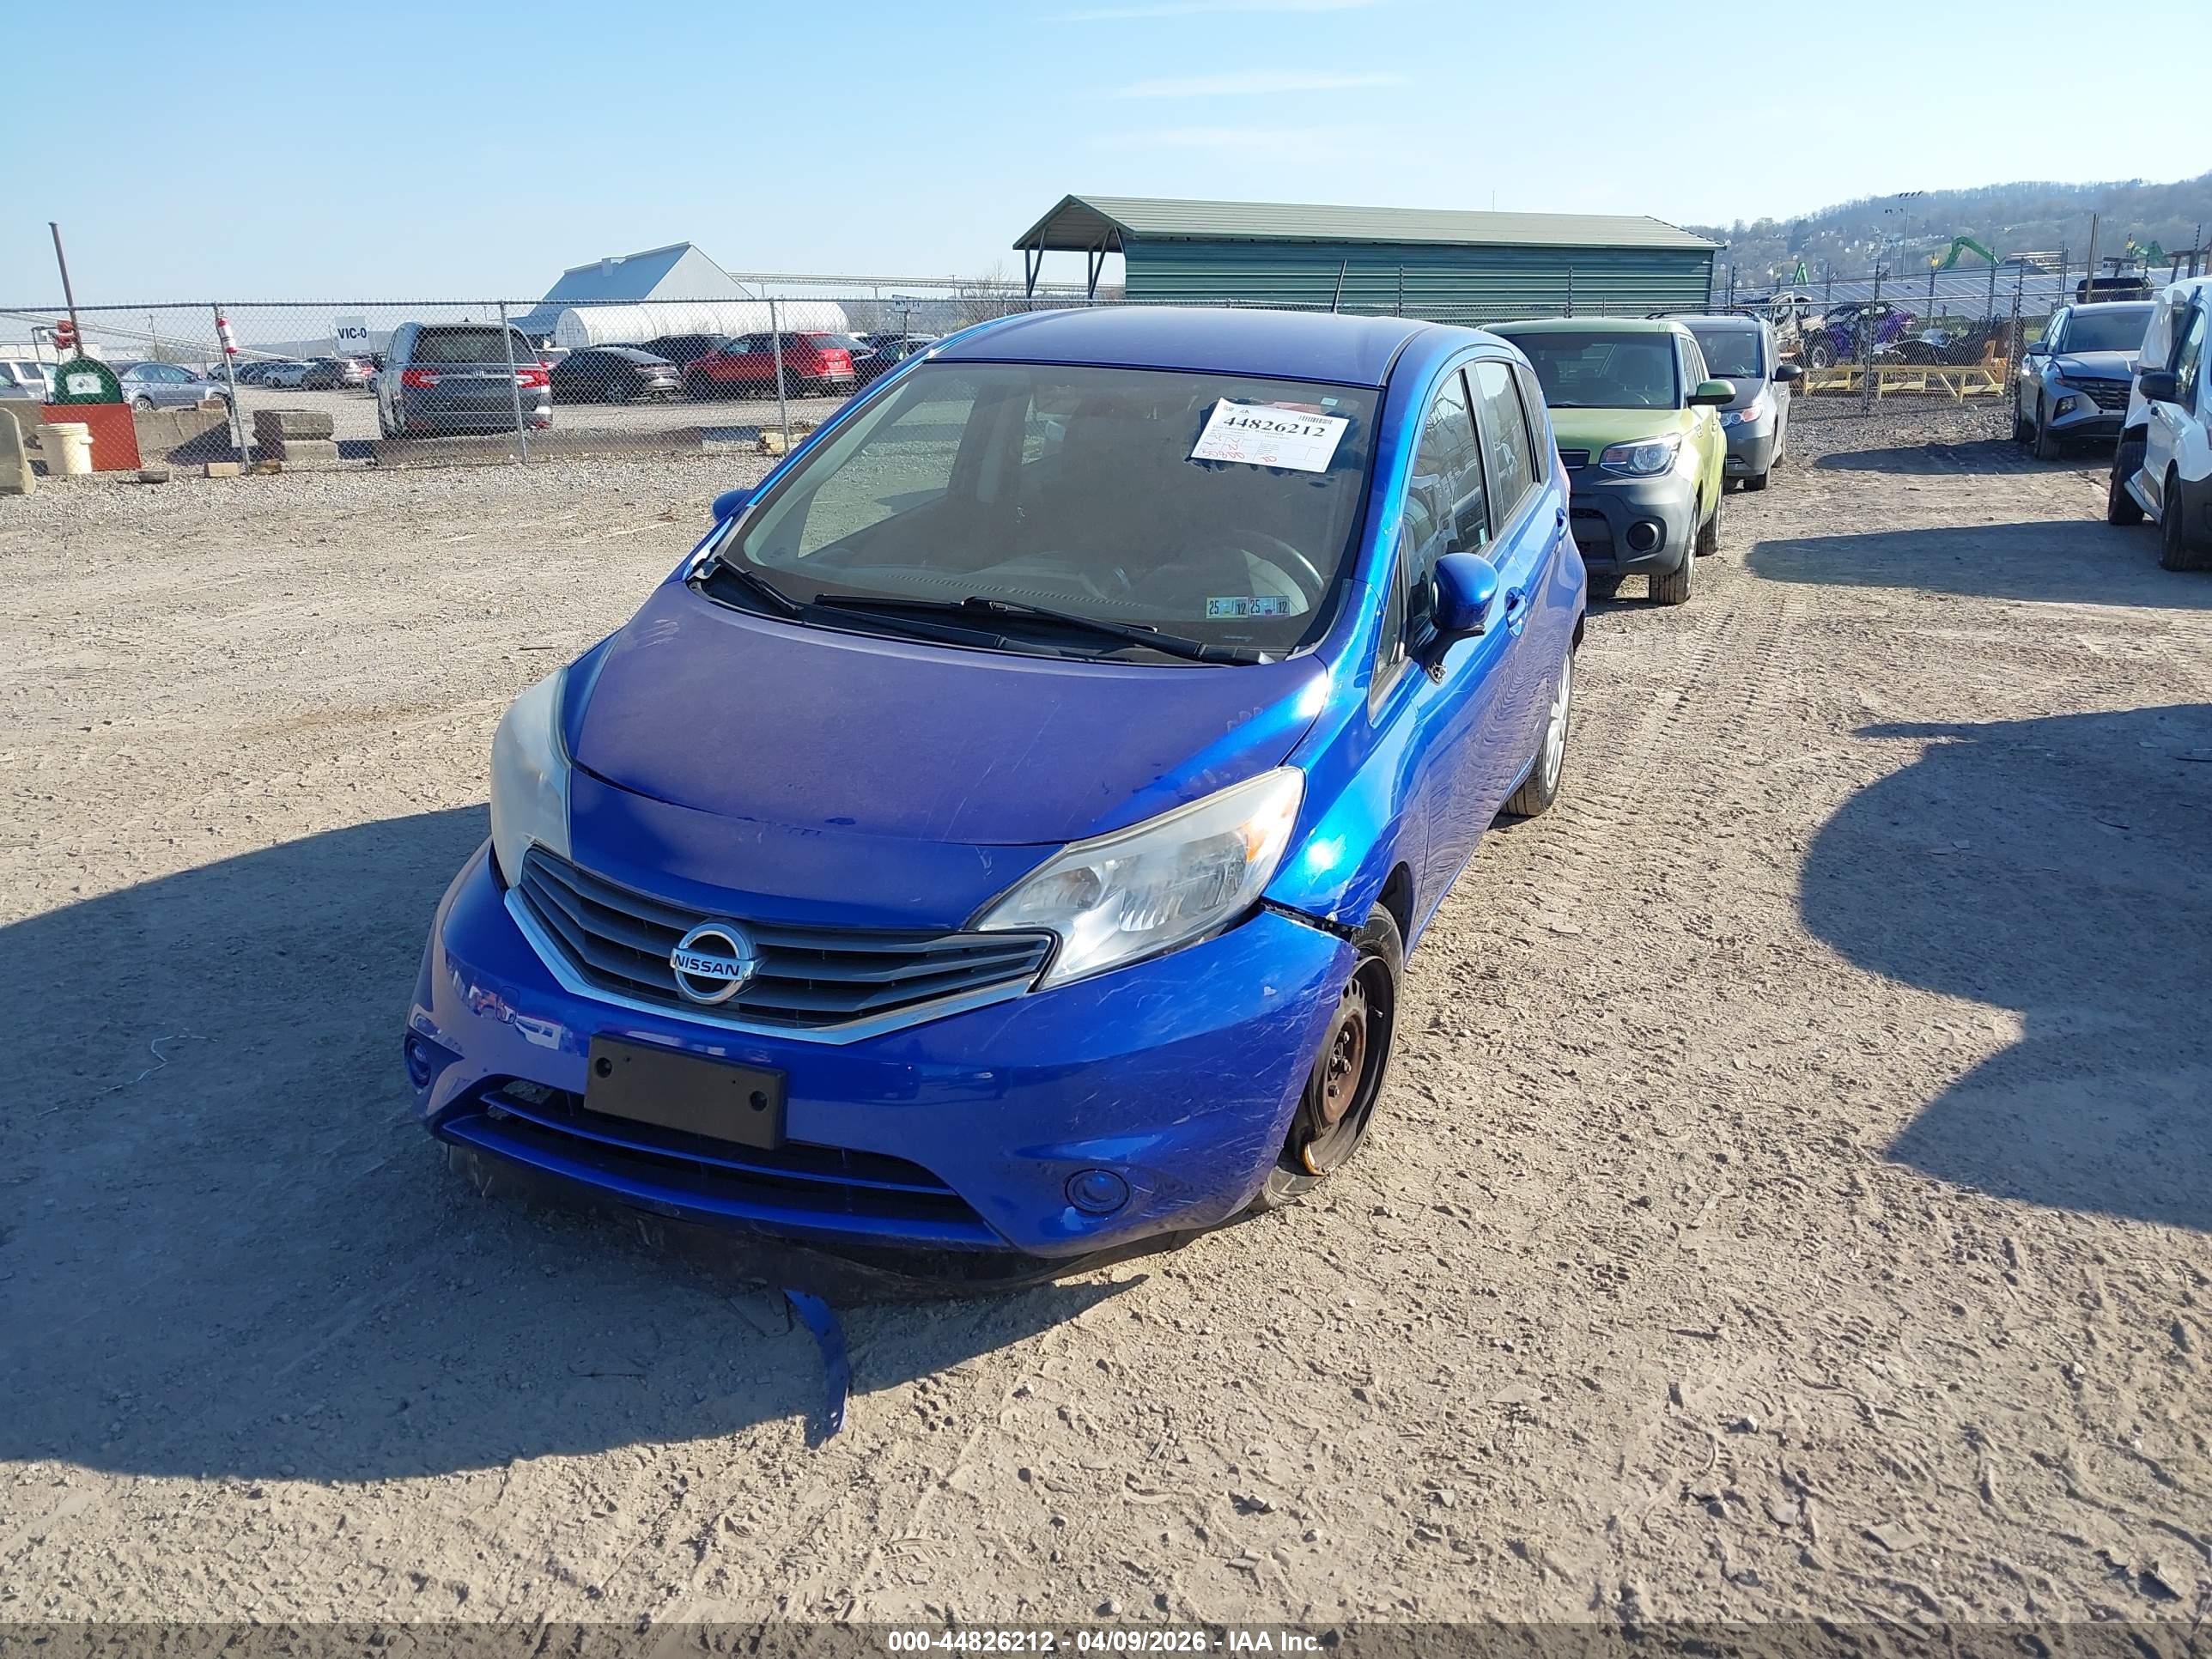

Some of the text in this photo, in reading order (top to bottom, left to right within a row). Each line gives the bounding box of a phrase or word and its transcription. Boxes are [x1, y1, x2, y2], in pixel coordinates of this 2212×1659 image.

[1223, 416, 1326, 437] 44826212
[1209, 600, 1247, 615] 25 12
[1250, 599, 1288, 614] 25 12
[674, 953, 740, 976] NISSAN
